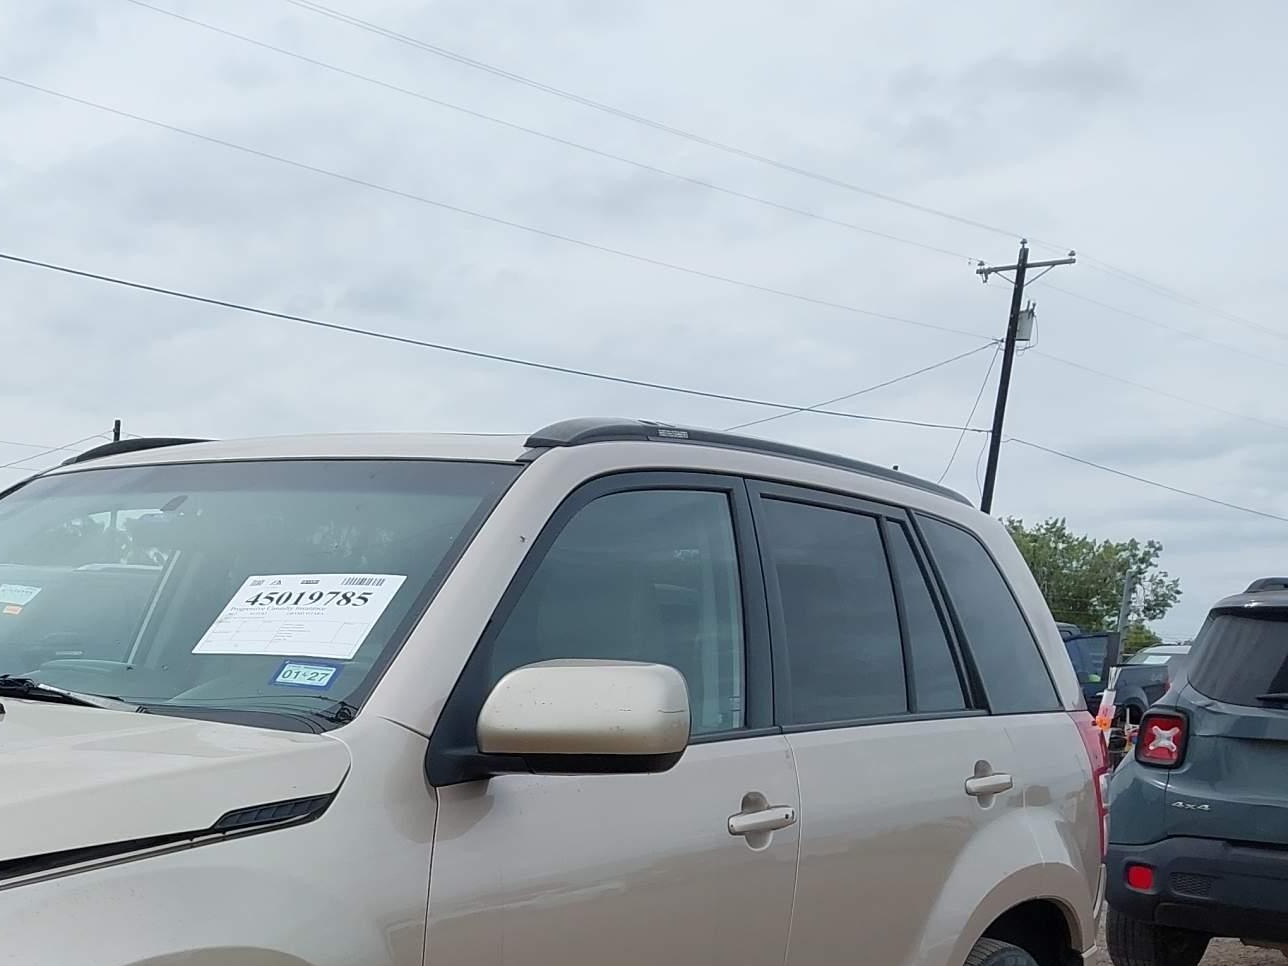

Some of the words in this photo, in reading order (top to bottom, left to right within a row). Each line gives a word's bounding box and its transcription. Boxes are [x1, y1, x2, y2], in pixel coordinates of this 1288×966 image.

[245, 591, 373, 606] 45019785
[282, 669, 301, 679] 01
[306, 671, 330, 682] 27
